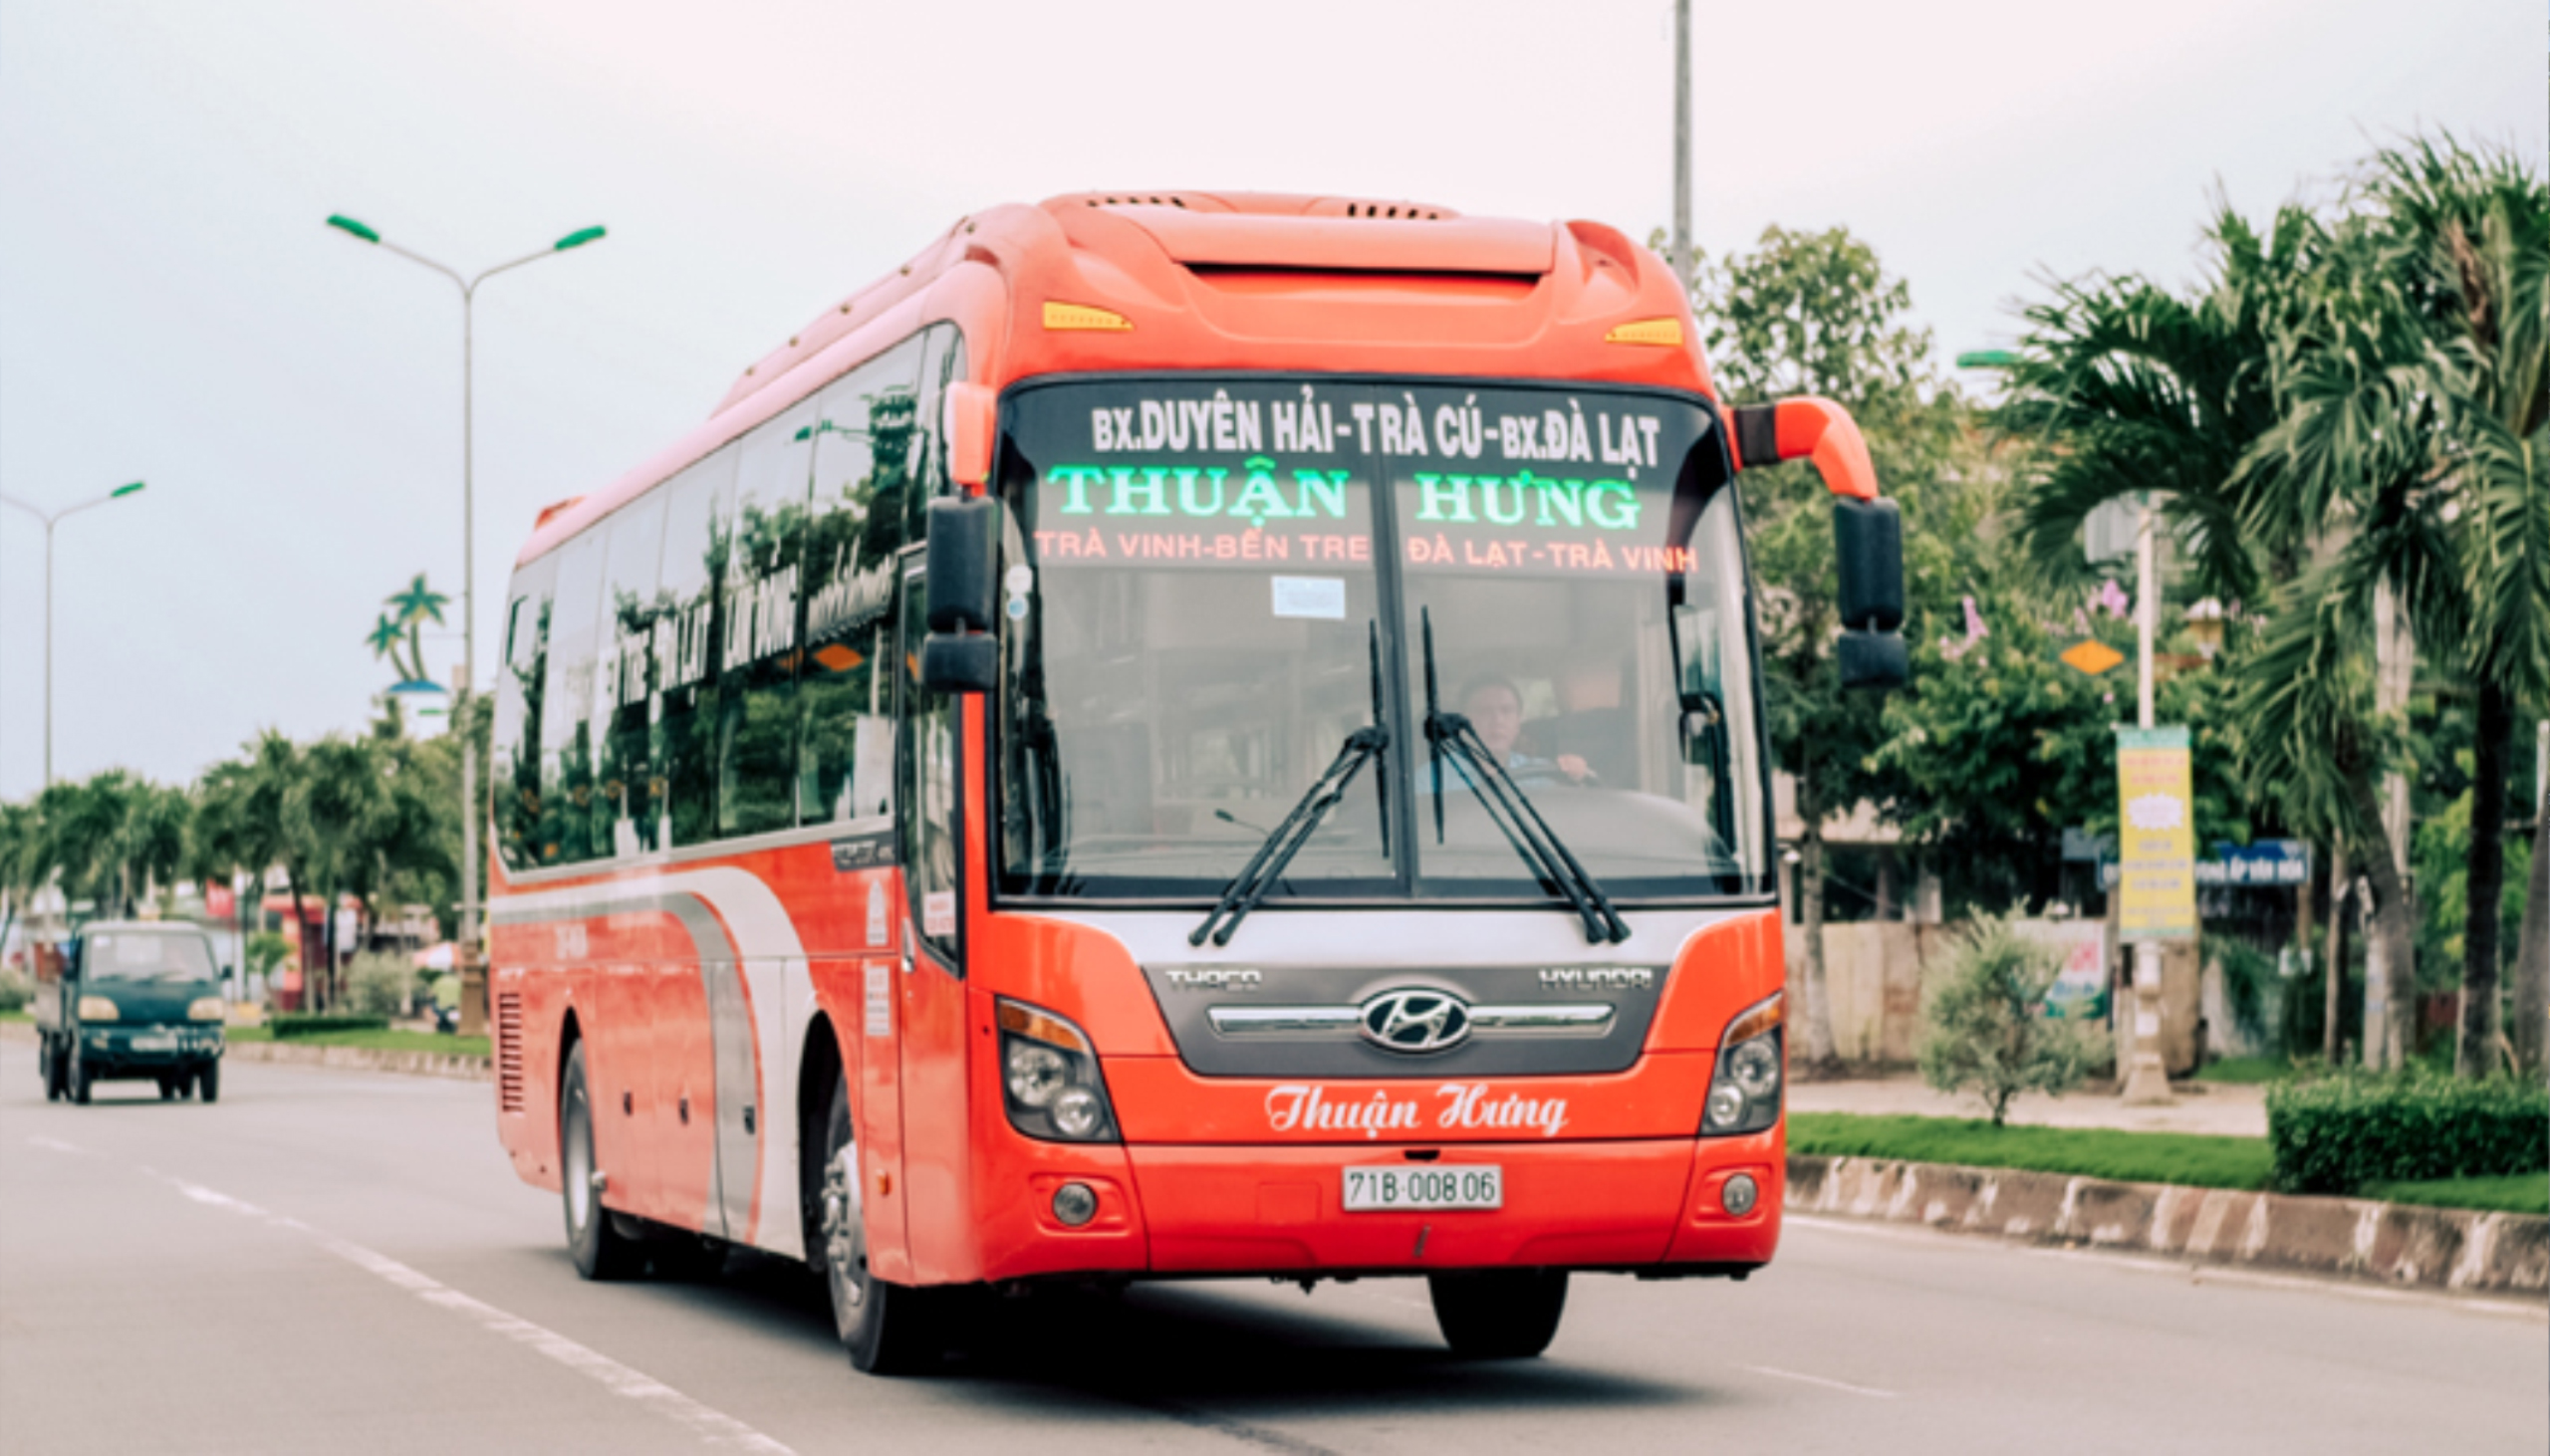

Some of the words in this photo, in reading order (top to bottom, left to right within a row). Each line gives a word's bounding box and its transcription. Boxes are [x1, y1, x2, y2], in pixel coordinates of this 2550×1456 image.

[1599, 412, 1660, 480] LẠT
[1047, 455, 1350, 527] THUẬN
[1414, 469, 1642, 529] HƯNG
[1033, 528, 1107, 558] TRÀ
[1299, 534, 1370, 561] TRE
[1407, 534, 1454, 564] ĐÀ
[1623, 547, 1698, 572] VINH
[1539, 967, 1653, 990] HYUNDAI
[1265, 1084, 1421, 1138] Thuận
[1435, 1084, 1569, 1137] Hưng
